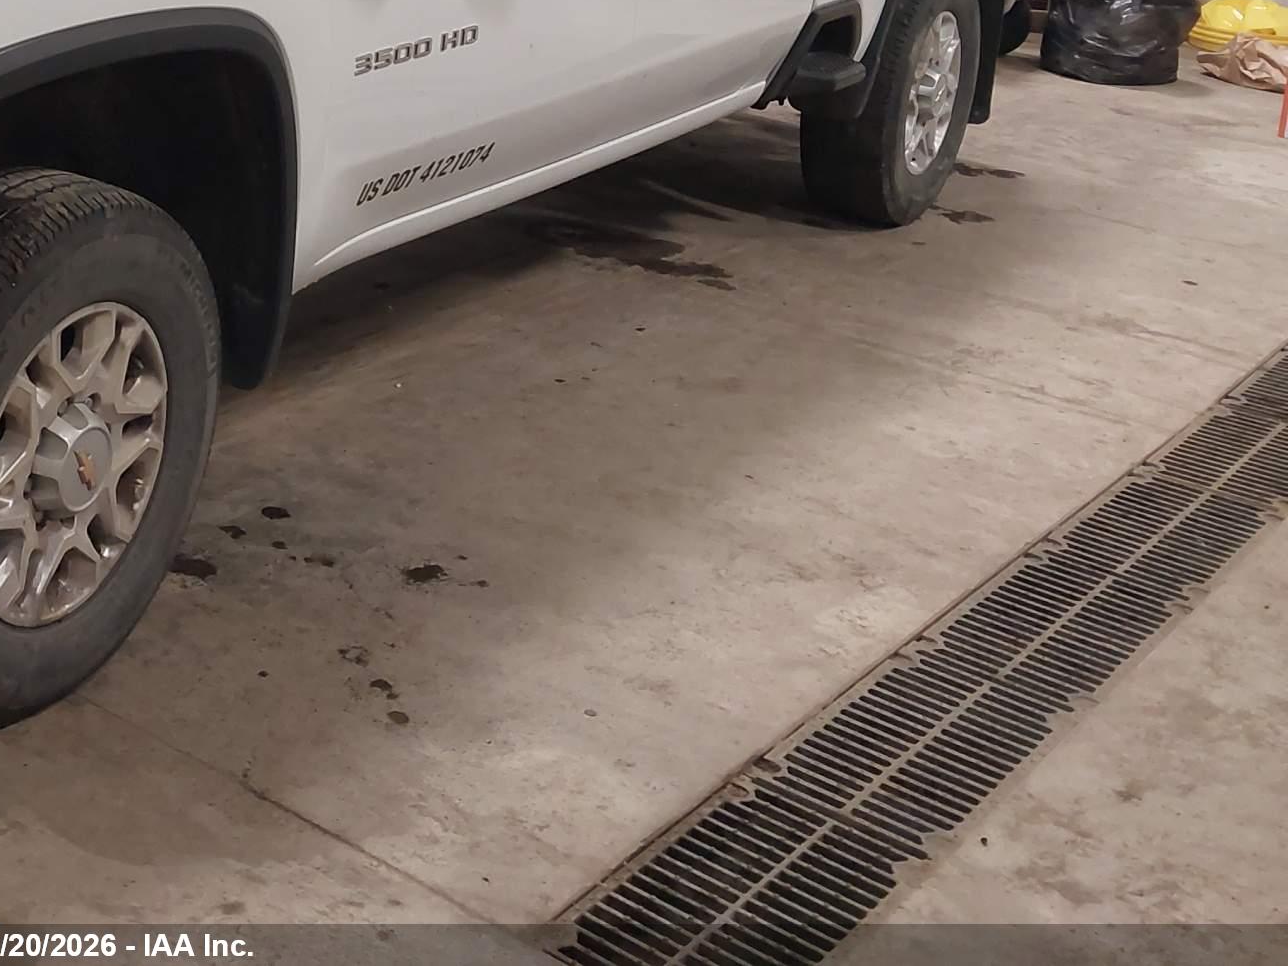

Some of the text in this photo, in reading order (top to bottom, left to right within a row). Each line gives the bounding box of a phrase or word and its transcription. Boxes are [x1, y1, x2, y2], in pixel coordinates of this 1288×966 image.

[354, 24, 479, 76] 3500 HD
[356, 141, 495, 206] US DOT 4121074
